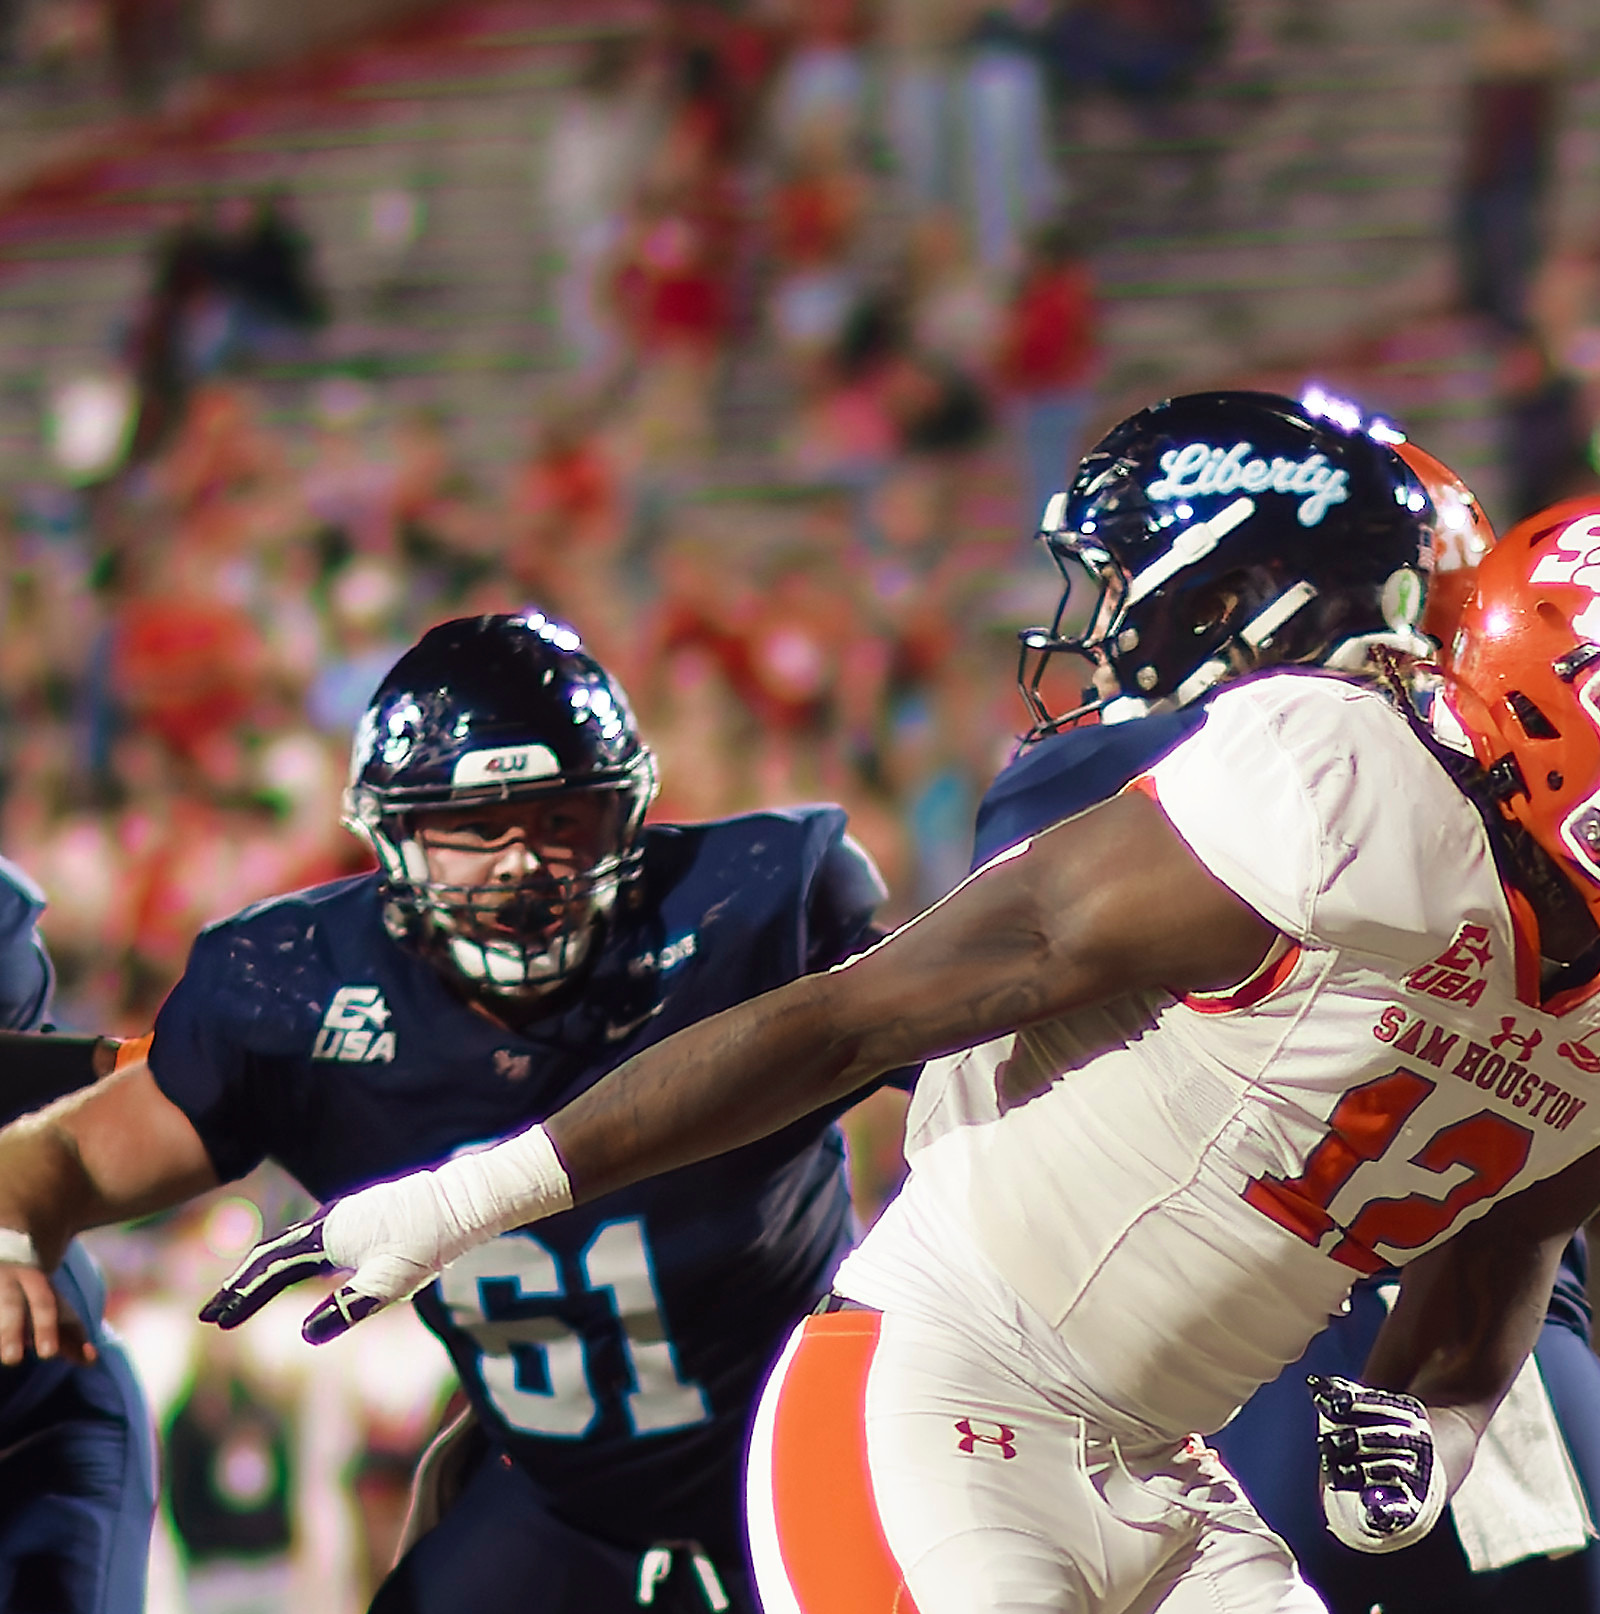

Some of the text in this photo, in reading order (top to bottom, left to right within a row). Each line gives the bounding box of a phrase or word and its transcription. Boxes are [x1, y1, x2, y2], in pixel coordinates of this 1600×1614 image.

[1147, 442, 1350, 527] Liberty
[1406, 963, 1488, 1009] USA
[311, 1030, 397, 1063] USA
[1373, 1006, 1587, 1133] SAM HOUSTON
[1239, 1066, 1534, 1275] 12
[435, 1214, 714, 1440] 61
